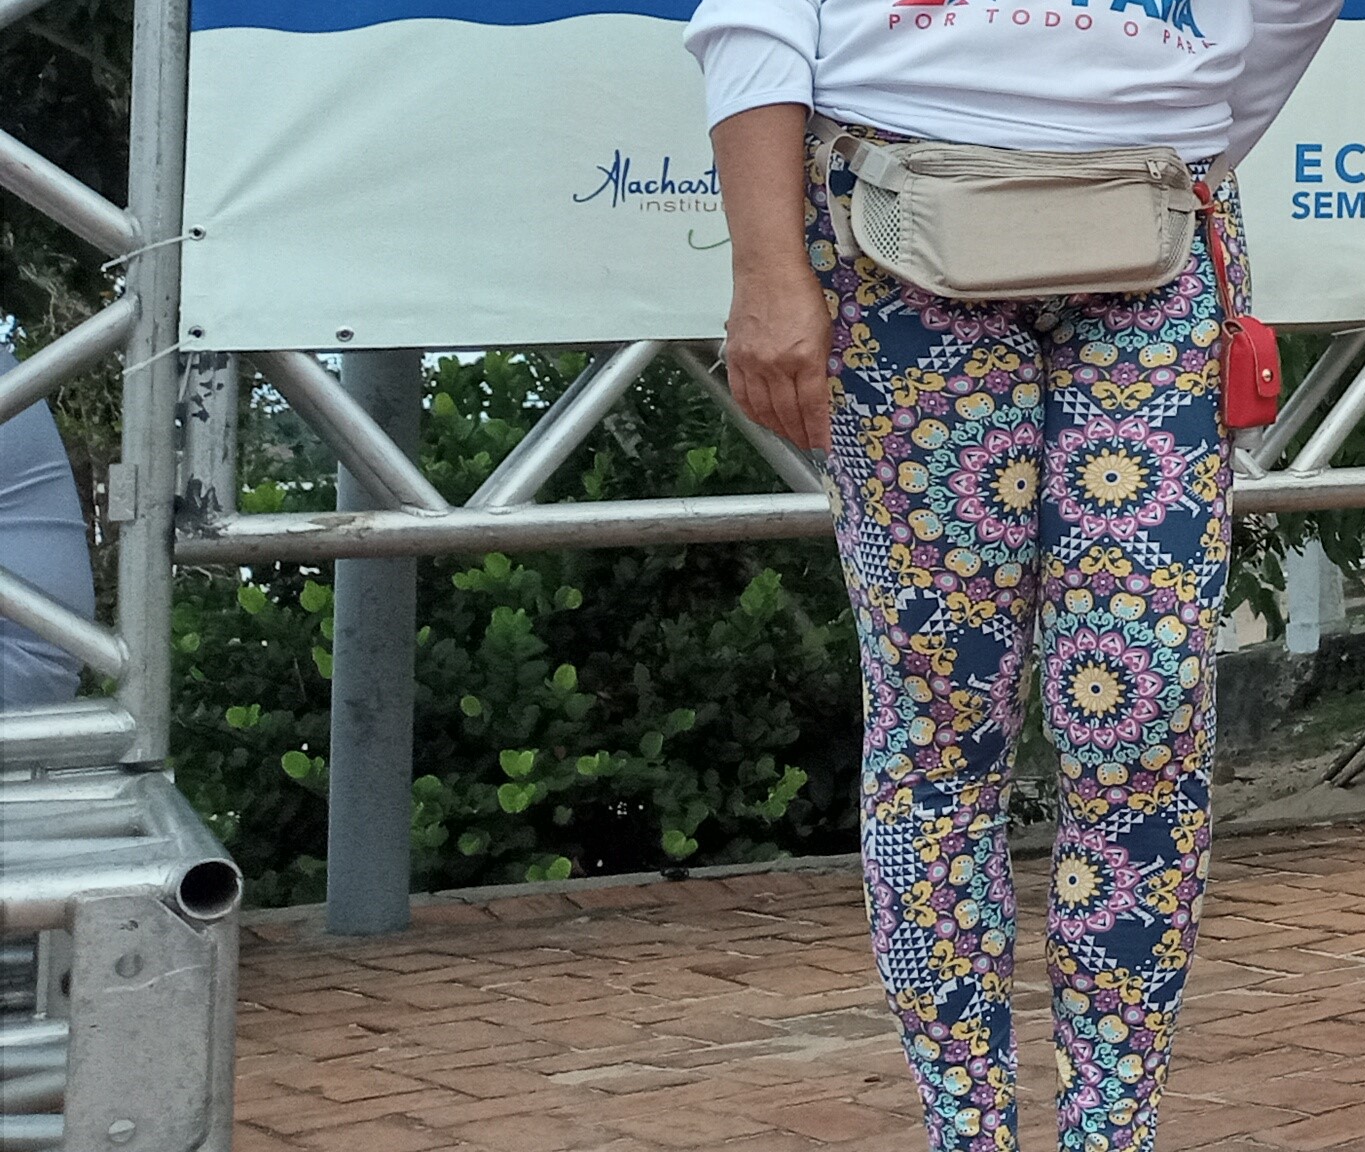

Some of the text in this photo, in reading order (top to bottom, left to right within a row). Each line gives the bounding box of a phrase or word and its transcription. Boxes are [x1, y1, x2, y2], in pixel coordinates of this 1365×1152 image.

[888, 12, 957, 30] POR
[986, 8, 1093, 30] TODO
[1123, 21, 1139, 37] O
